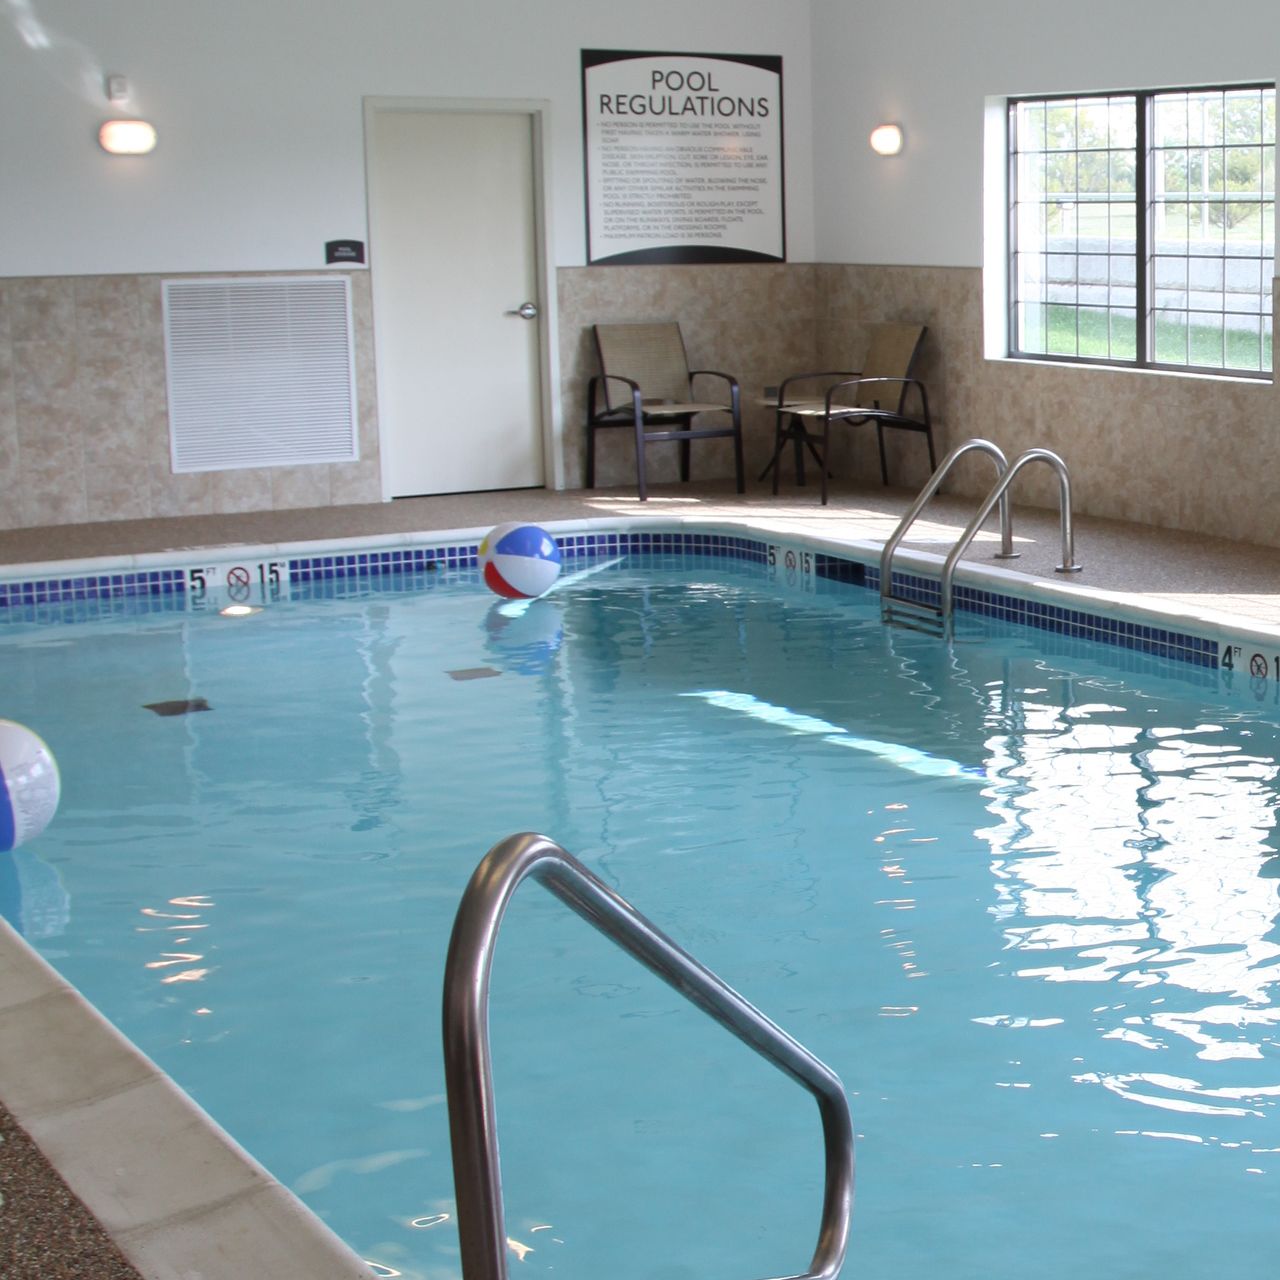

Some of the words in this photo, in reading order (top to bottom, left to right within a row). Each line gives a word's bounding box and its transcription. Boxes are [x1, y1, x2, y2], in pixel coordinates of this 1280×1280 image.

[652, 70, 719, 92] POOL
[600, 94, 768, 118] REGULATIONS
[768, 545, 776, 566] 5
[190, 568, 206, 590] 5
[1222, 646, 1234, 671] 4
[1234, 647, 1242, 658] FT
